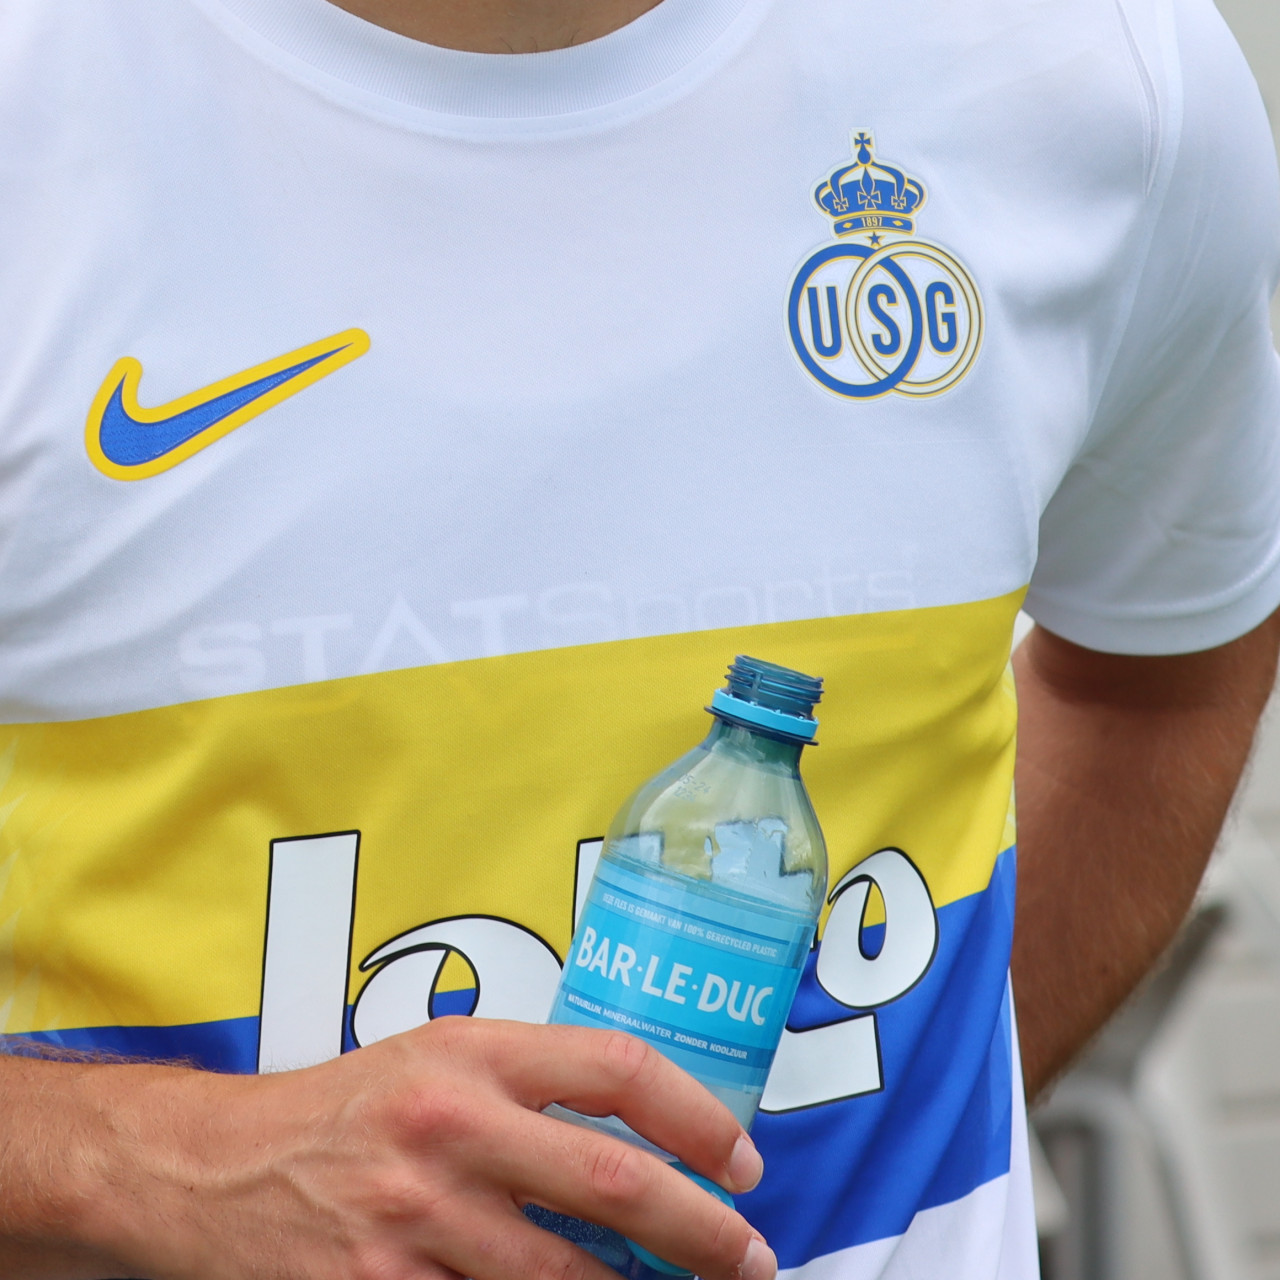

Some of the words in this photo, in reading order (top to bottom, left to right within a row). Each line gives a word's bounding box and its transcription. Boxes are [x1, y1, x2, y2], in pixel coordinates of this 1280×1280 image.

[861, 216, 883, 227] 1897
[806, 280, 959, 360] USG
[614, 897, 627, 911] FLES
[627, 903, 635, 914] IS
[635, 906, 666, 924] GEMAAKT
[668, 917, 682, 930] VAN
[683, 923, 705, 938] 100%
[706, 930, 751, 951] GERECYCLED
[752, 944, 778, 958] PLASTIC
[567, 993, 602, 1015] NATUURLIJK
[602, 1007, 671, 1039] MINERAALWATER
[673, 1032, 708, 1050] ZONDER
[709, 1043, 748, 1060] KOOLZUUR
